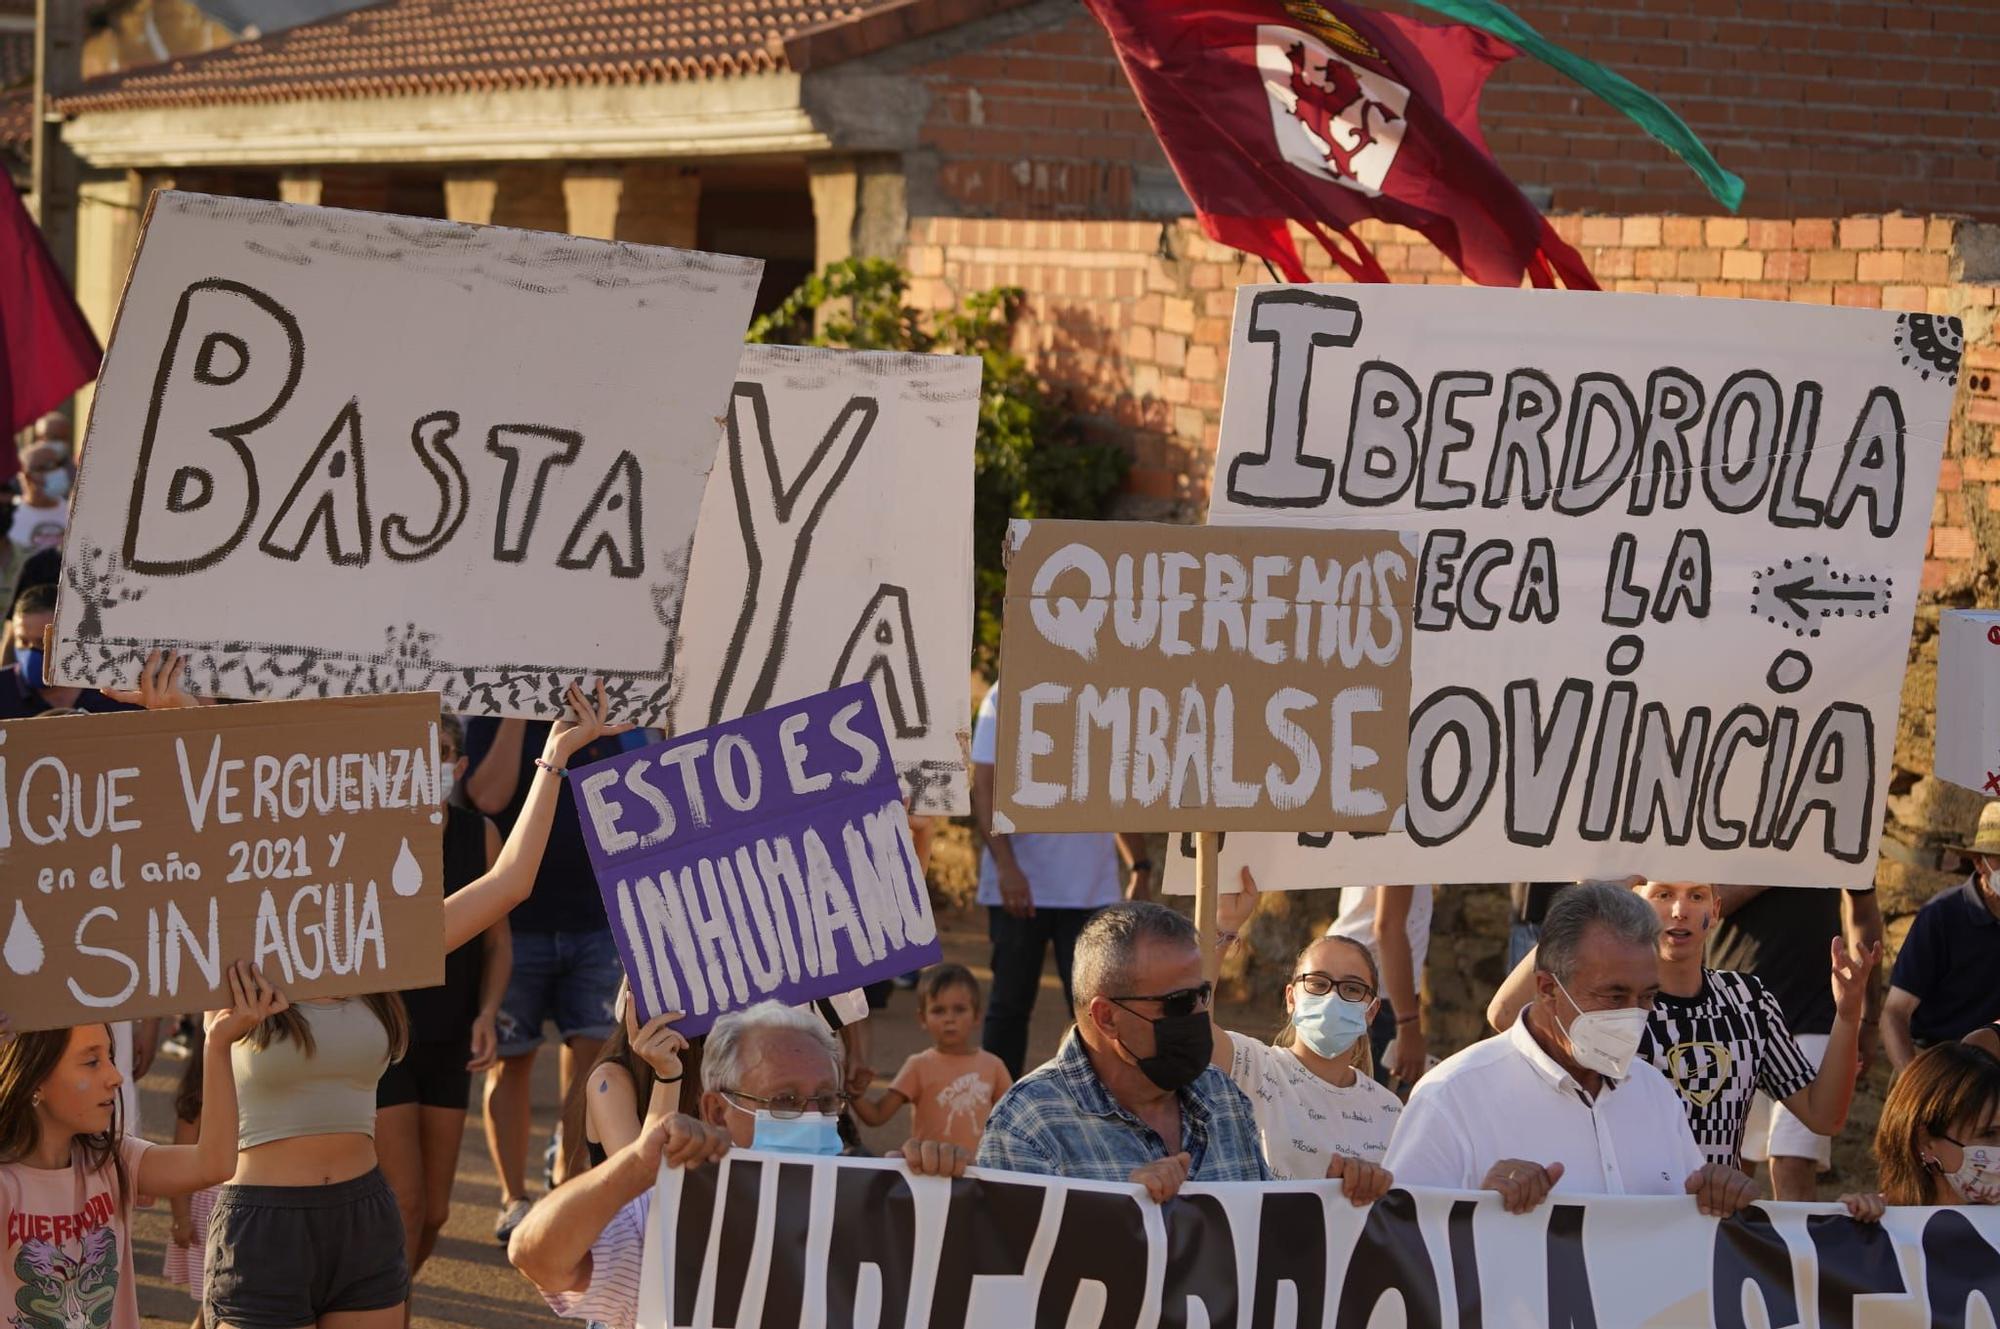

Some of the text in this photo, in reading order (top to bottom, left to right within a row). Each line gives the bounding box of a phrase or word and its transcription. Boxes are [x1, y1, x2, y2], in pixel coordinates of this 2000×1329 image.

[124, 278, 645, 578] BASTA
[1227, 287, 1908, 538] IBERDROLA
[708, 381, 930, 738] YA
[1029, 543, 1407, 669] QUEREMOS
[1413, 528, 1711, 631] ECA LA
[580, 699, 881, 856] ESTO ES
[1011, 680, 1388, 817] EMBALSE
[37, 866, 75, 894] en
[89, 843, 126, 890] el
[140, 852, 201, 883] año
[226, 835, 313, 883] 2021
[616, 799, 937, 1018] INHUMANO
[67, 880, 387, 1008] SIN AGUA
